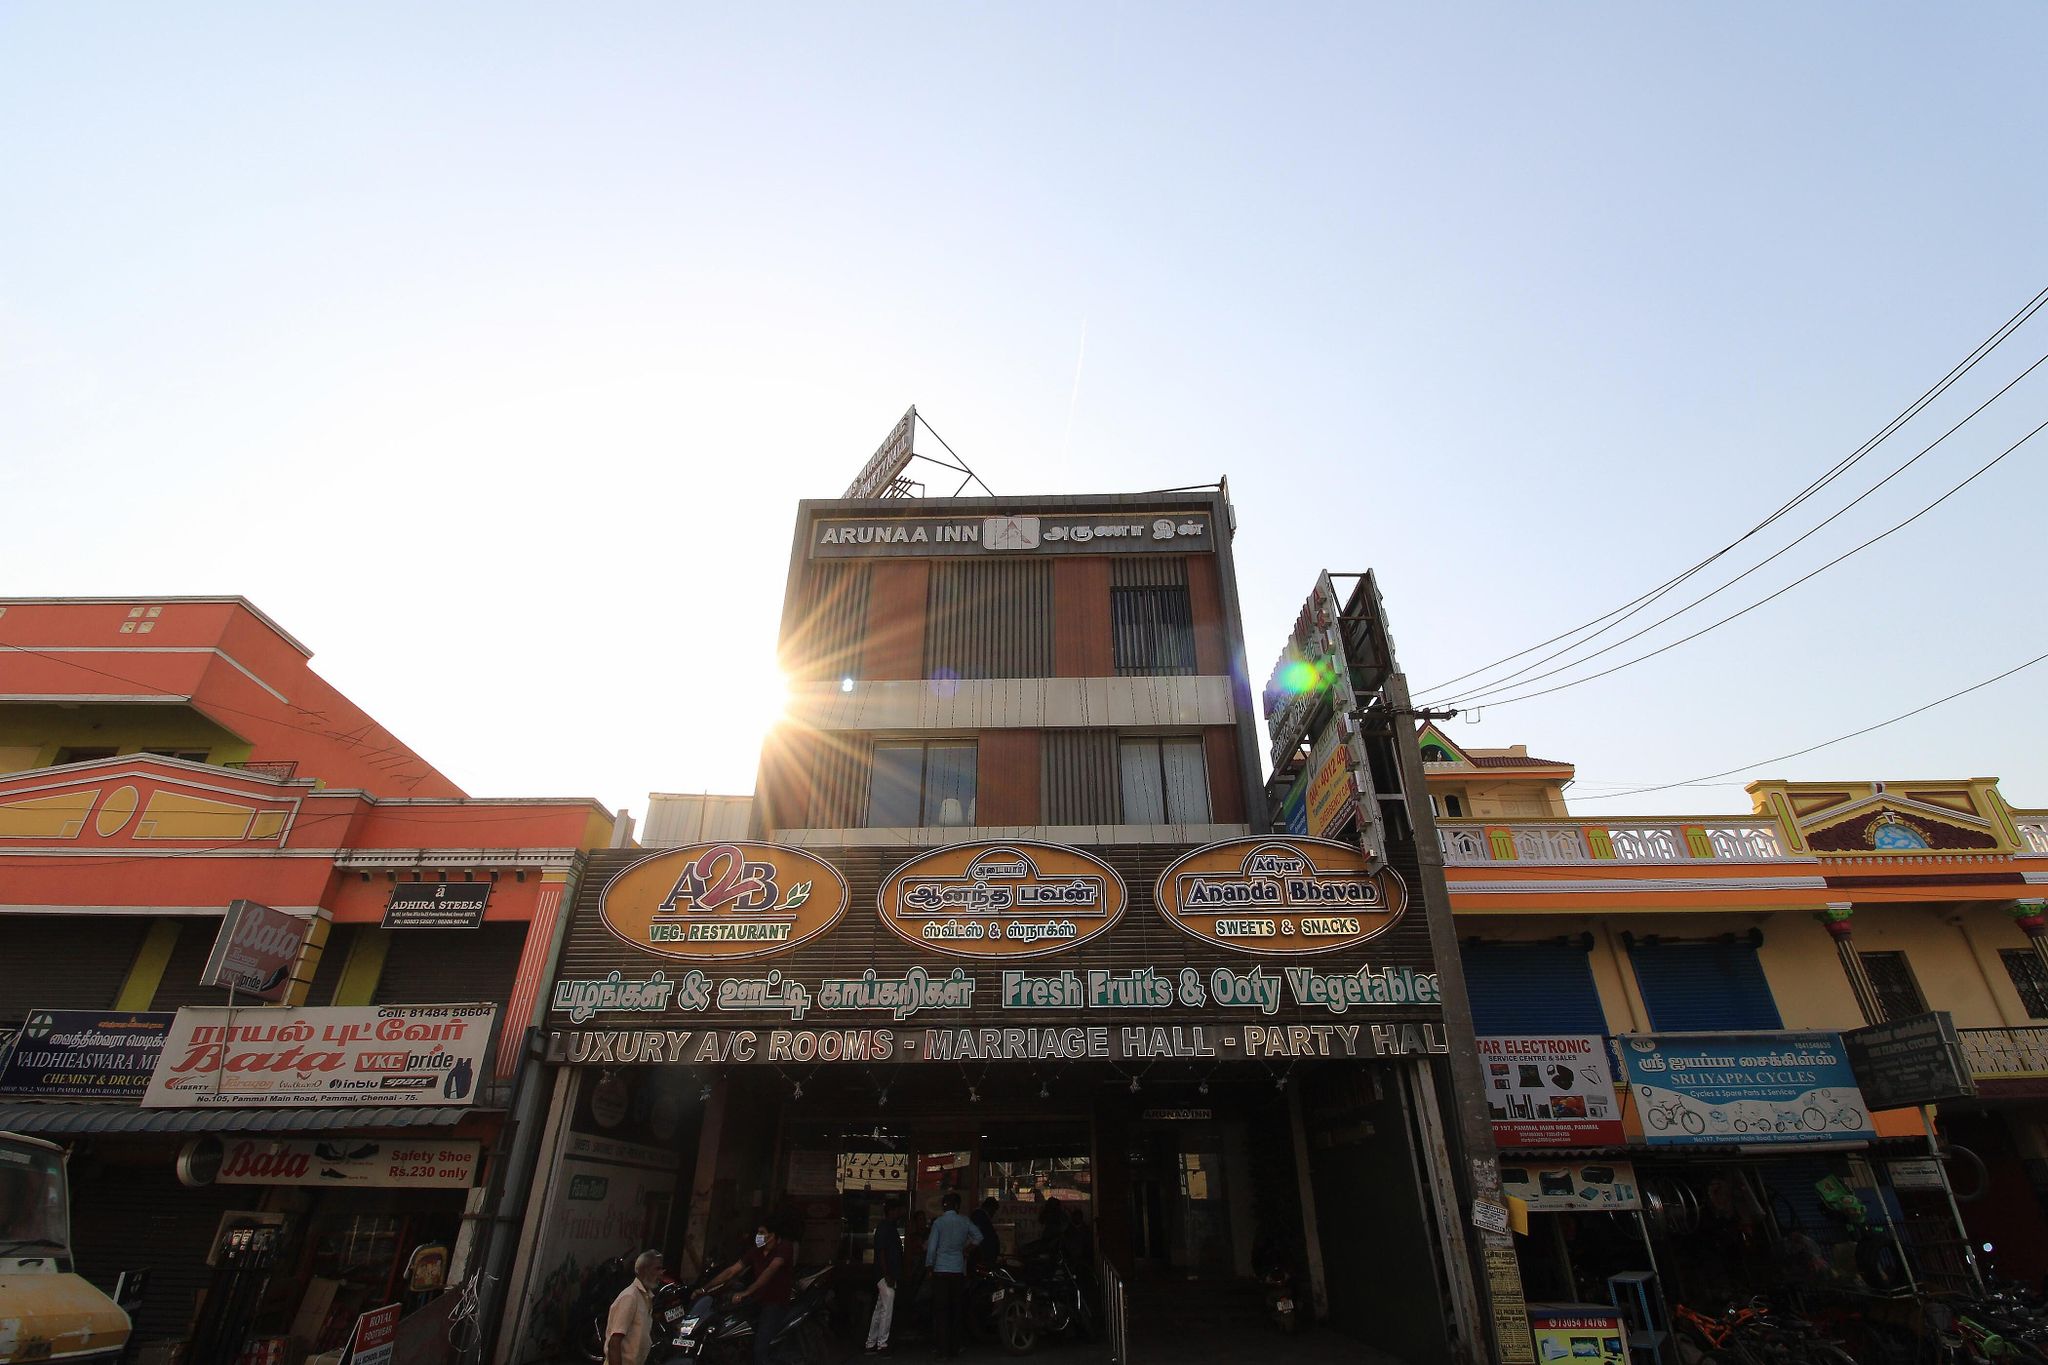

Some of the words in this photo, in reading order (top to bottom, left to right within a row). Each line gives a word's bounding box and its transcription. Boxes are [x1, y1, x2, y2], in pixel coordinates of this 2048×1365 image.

[820, 526, 929, 545] ARUNAA
[936, 525, 979, 543] INN
[1043, 524, 1144, 542] அருணா
[1152, 518, 1204, 540] இன்
[1249, 854, 1304, 879] Adyar
[658, 845, 780, 912] A2B
[904, 880, 1013, 915] ஆனந்த
[1016, 880, 1097, 907] பவன்
[1185, 878, 1279, 906] Ananda
[1286, 877, 1381, 904] Bhavan
[390, 901, 435, 910] ADHIRA
[438, 901, 483, 910] STEELS
[233, 908, 301, 961] Bata
[649, 924, 685, 942] VEG.
[688, 922, 791, 941] RESTAURANT
[989, 922, 1001, 939] &
[1216, 919, 1275, 937] SWEETS
[1282, 920, 1295, 935] &
[1300, 917, 1360, 935] SNACKS
[552, 970, 674, 1024] பழங்கள்
[678, 969, 713, 1010] &
[717, 969, 810, 1021] ஊட்டி
[818, 966, 976, 1020] காய்கறிகள்
[1002, 970, 1084, 1009] Fresh
[1088, 967, 1173, 1008] Fruits
[1178, 966, 1207, 1007] &
[1211, 965, 1281, 1015] Ooty
[1285, 964, 1442, 1013] Vegetables
[378, 1009, 406, 1018] Cell:
[410, 1008, 449, 1017] 81484
[452, 1008, 491, 1017] 58604
[190, 1020, 315, 1043] ராயல்
[322, 1018, 468, 1047] புட்வேர்
[549, 1031, 692, 1062] LUXURY
[699, 1030, 757, 1062] A/C
[768, 1029, 895, 1062] ROOMS
[923, 1028, 1109, 1061] MARRIAGE
[1121, 1026, 1215, 1058] HALL
[1245, 1025, 1360, 1057] PARTY
[1371, 1024, 1449, 1055] HAL
[1476, 1039, 1502, 1055] TAR
[1504, 1039, 1591, 1054] ELECTRONIC
[16, 1051, 133, 1069] VAIDHIEASWARA
[170, 1043, 346, 1073] Bata
[360, 1055, 404, 1069] VKC
[408, 1051, 453, 1071] pride
[41, 1073, 95, 1084] CHEMIST
[96, 1074, 106, 1085] &
[343, 1079, 379, 1088] inblu
[1671, 1073, 1698, 1085] SRI
[1700, 1072, 1753, 1085] IYAPPA
[1756, 1072, 1817, 1084] CYCLES
[293, 1095, 318, 1103] Road,
[321, 1095, 358, 1103] Pammal,
[1690, 1090, 1714, 1098] Cycles
[1722, 1090, 1741, 1098] Spare
[1768, 1088, 1797, 1096] Services
[222, 1142, 311, 1179] Bata
[391, 1150, 434, 1164] Safety
[439, 1151, 472, 1162] Shoe
[389, 1166, 436, 1177] Rs.230
[440, 1167, 468, 1180] only
[369, 1312, 393, 1327] ROYAL
